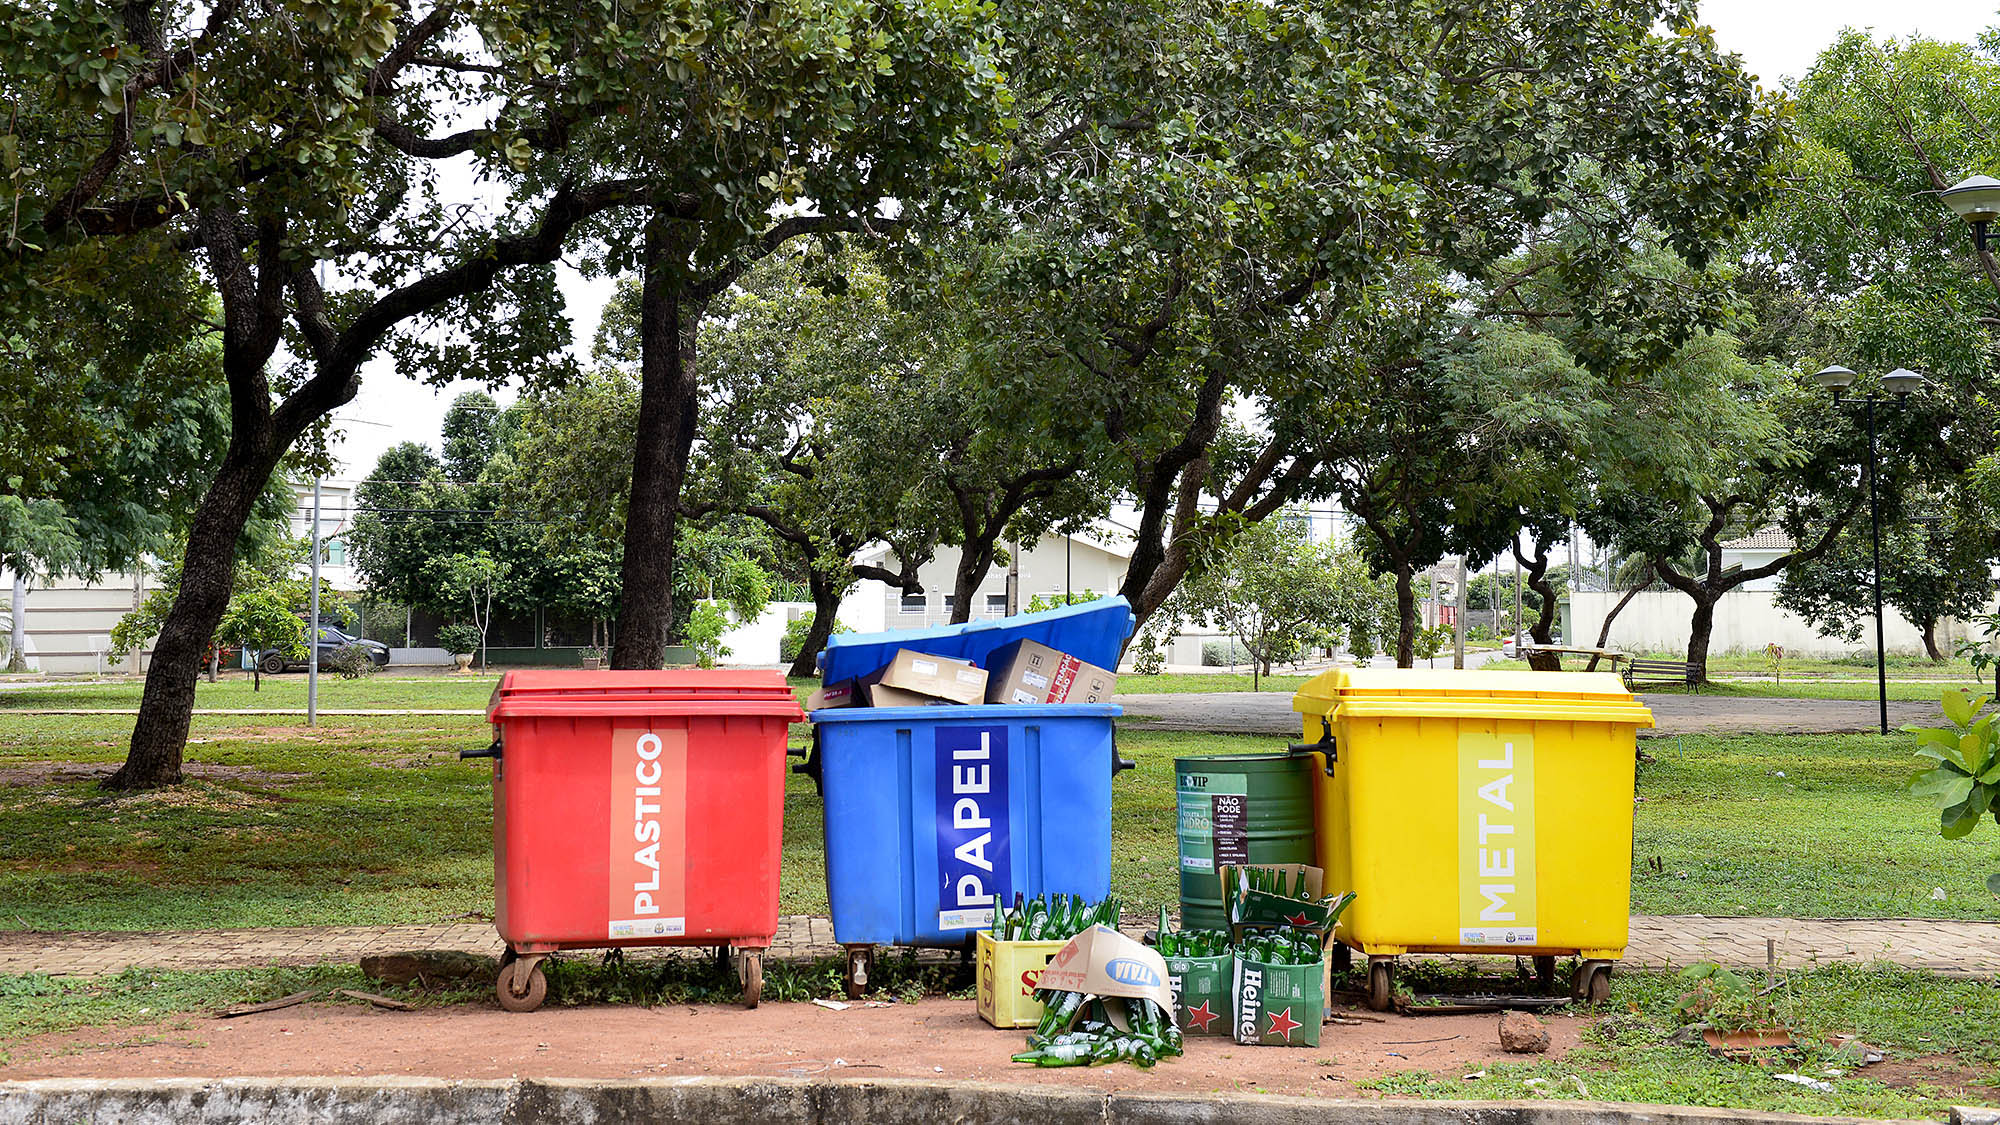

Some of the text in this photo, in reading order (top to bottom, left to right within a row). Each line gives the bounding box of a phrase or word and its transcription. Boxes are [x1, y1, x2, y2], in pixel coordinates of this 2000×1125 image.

[1055, 654, 1072, 685] FRAÇÃO
[1217, 805, 1240, 813] PODE
[1219, 796, 1239, 805] NÃO
[634, 733, 663, 915] PLASTICO
[953, 731, 995, 907] PAPEL
[1478, 742, 1516, 921] METAL
[1115, 961, 1153, 984] ITAJÁ
